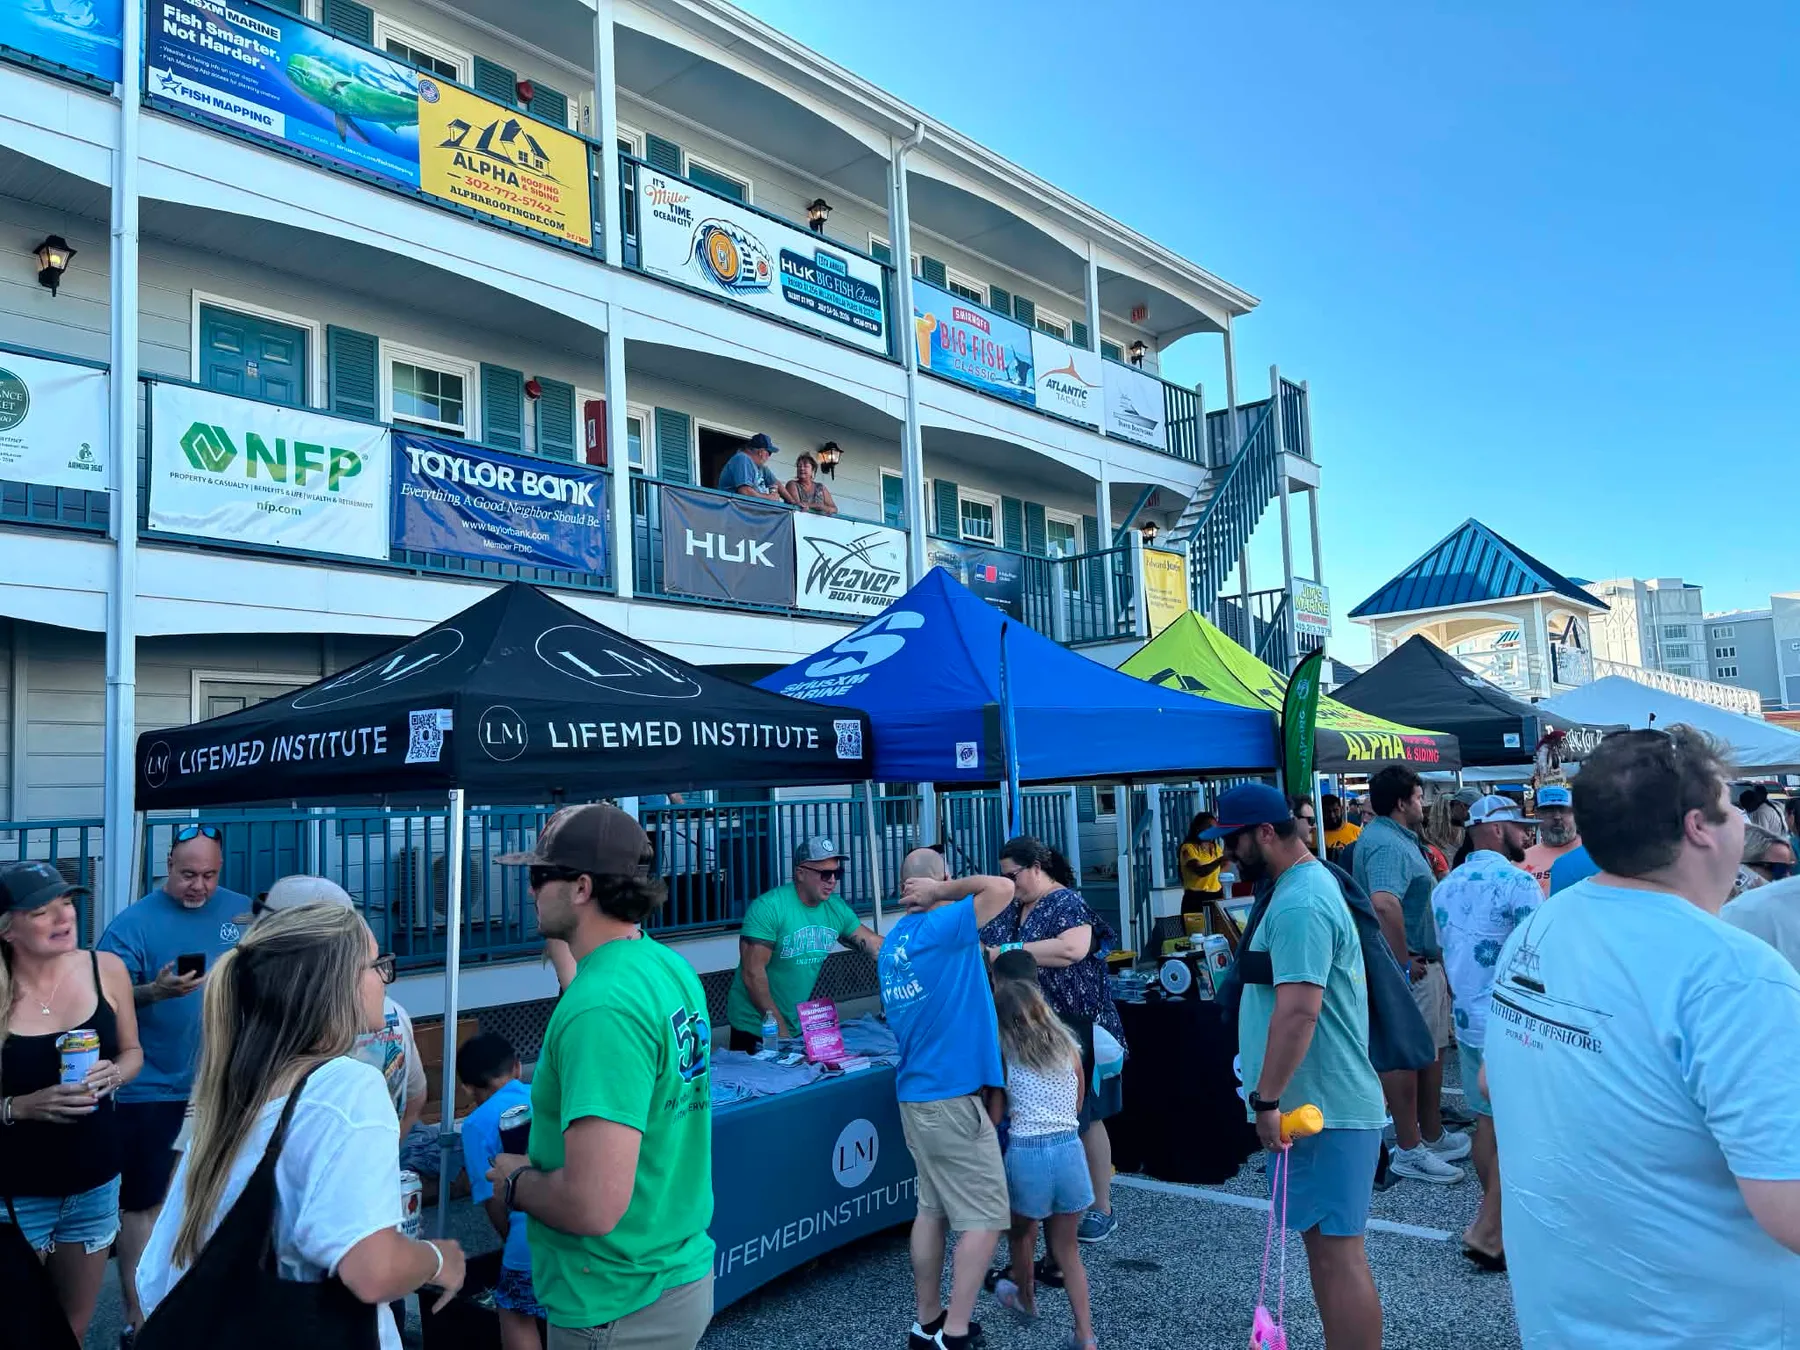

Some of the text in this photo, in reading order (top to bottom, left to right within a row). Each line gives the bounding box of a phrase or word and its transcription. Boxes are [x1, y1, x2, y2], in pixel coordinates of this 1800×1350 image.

[163, 3, 281, 62] Fish Smarter,
[227, 9, 279, 40] MARINE
[163, 19, 266, 70] Not Harder.
[180, 86, 272, 126] FISH MAPPING
[453, 152, 520, 188] ALPHA
[521, 175, 560, 195] ROOFING
[652, 177, 666, 189] IT'S
[450, 185, 565, 231] ALPHAROOFINGDE.COM
[465, 175, 553, 214] 302-772-5742
[531, 186, 560, 203] SIDING
[644, 185, 690, 206] Miller
[653, 209, 692, 228] OCEAN CITY
[781, 257, 816, 282] HUK
[816, 270, 833, 289] BIG
[834, 277, 854, 298] FISH
[954, 310, 990, 333] SMIRNOFF
[940, 321, 1006, 372] BIG FISH
[954, 357, 997, 382] CLASSIC
[246, 431, 362, 492] NFP
[170, 472, 207, 484] PROPERTY
[214, 479, 249, 491] CASUALTY
[254, 485, 285, 496] BENEFITS
[291, 490, 303, 499] LIFE
[306, 493, 332, 503] WEALTH
[338, 498, 374, 509] RETIREMENT
[401, 483, 600, 528] Everything A Good Neighbor Should Be
[257, 501, 302, 516] nfp.com
[461, 520, 550, 541] www.taylorbank.com
[483, 539, 533, 554] Member FDIC
[685, 528, 776, 568] HUK
[828, 591, 894, 607] BOAT WORK
[1294, 594, 1329, 617] MARINE
[1301, 583, 1323, 602] JIM'S
[558, 649, 687, 683] LM
[486, 720, 819, 749] LM LIFEMED INSTITUTE
[1340, 732, 1406, 761] ALPHA
[180, 740, 264, 774] LIFEMED
[270, 726, 387, 762] INSTITUTE
[1406, 747, 1439, 763] & SIDING
[893, 980, 923, 1000] SLICE
[1525, 1015, 1537, 1032] BE
[1539, 1023, 1603, 1054] OFFSHORE
[839, 1136, 874, 1173] LM
